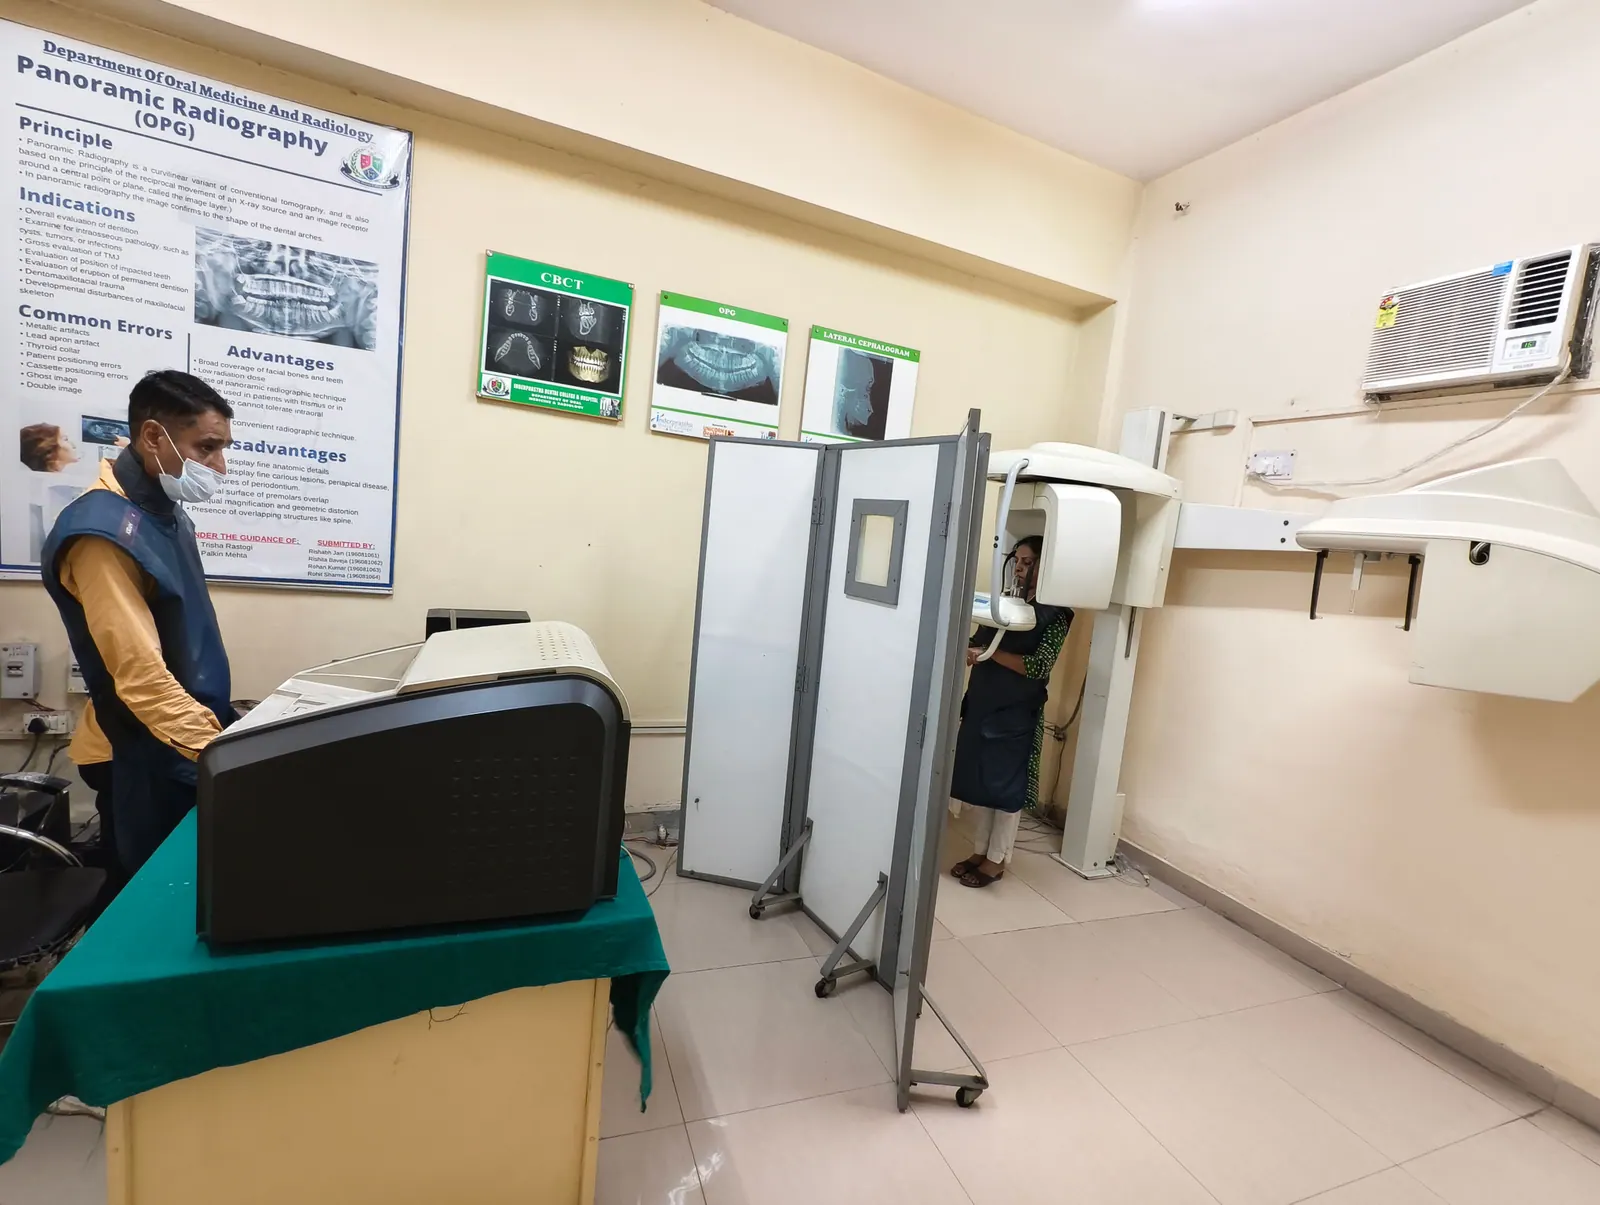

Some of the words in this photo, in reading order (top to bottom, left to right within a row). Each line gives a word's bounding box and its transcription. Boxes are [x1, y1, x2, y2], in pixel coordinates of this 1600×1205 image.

[43, 40, 142, 78] Department
[145, 69, 162, 84] Of
[165, 76, 196, 93] Oral
[200, 84, 266, 112] Medicine
[270, 104, 298, 122] And
[302, 114, 374, 143] Radiology
[18, 55, 164, 110] Panoramic
[173, 97, 328, 156] Radiography
[20, 116, 113, 150] Principle
[135, 110, 195, 141] (OPG)
[20, 187, 136, 222] Indications
[35, 173, 81, 188] panoramic
[83, 183, 130, 199] radiography
[146, 198, 168, 207] image
[170, 203, 201, 215] confirms
[225, 216, 248, 225] shape
[273, 226, 296, 235] dental
[298, 232, 323, 241] arches.
[24, 207, 54, 217] Overall
[56, 214, 96, 226] evaluation
[107, 224, 139, 234] dentition
[19, 227, 42, 236] cysts,
[45, 231, 75, 242] tumors,
[87, 240, 122, 251] infections
[25, 217, 61, 229] Examine
[75, 227, 122, 241] intraosseous
[124, 237, 160, 249] pathology,
[24, 237, 50, 247] Gross
[52, 243, 92, 254] evaluation
[103, 251, 119, 260] TMJ
[24, 247, 68, 260] Evaluation
[79, 258, 108, 268] position
[119, 265, 152, 276] impacted
[23, 267, 97, 285] Dentomaxillofacial
[99, 281, 124, 290] trauma
[25, 257, 68, 270] Evaluation
[79, 268, 110, 277] eruption
[120, 275, 158, 287] permanent
[160, 283, 188, 293] dentition
[540, 272, 583, 290] CBCT
[19, 288, 56, 297] skeleton
[24, 277, 85, 293] Developmental
[87, 289, 133, 301] disturbances
[144, 299, 185, 311] maxillofacial
[19, 304, 112, 330] Common
[118, 319, 173, 340] Errors
[718, 307, 736, 317] OPG
[25, 321, 57, 331] Metallic
[59, 327, 92, 336] artifacts
[24, 340, 57, 351] Thyroid
[824, 332, 856, 346] LATERAL
[857, 339, 910, 357] CEPHALOGRAM
[26, 351, 55, 360] Patient
[57, 356, 98, 367] positioning
[198, 358, 218, 366] Broad
[220, 362, 254, 372] coverage
[286, 370, 309, 379] bones
[227, 346, 334, 371] Advantages
[25, 371, 51, 379] Ghost
[53, 374, 77, 383] image
[26, 361, 63, 371] Cassette
[64, 367, 104, 378] positioning
[213, 370, 245, 378] radiation
[25, 380, 56, 390] Double
[224, 380, 265, 390] panoramic
[266, 386, 311, 397] radiographic
[312, 392, 345, 402] technique
[236, 400, 264, 408] cannot
[264, 404, 292, 413] tolerate
[231, 420, 274, 430] convenient
[275, 425, 319, 436] radiographic
[321, 431, 355, 440] technique.
[226, 440, 347, 463] sadvantages
[226, 457, 254, 467] display
[272, 463, 304, 472] anatomic
[306, 466, 328, 474] details
[225, 467, 254, 477] display
[299, 475, 326, 484] lesions,
[362, 482, 388, 490] disease,
[250, 481, 299, 490] periodontium.
[191, 505, 227, 514] Presence
[237, 510, 281, 519] overlapping
[224, 499, 274, 508] magnification
[194, 531, 217, 540] NDER
[220, 533, 237, 541] THE
[240, 534, 283, 544] GUIDANCE
[225, 543, 255, 551] Rastogi
[318, 540, 360, 548] SUBMITTED
